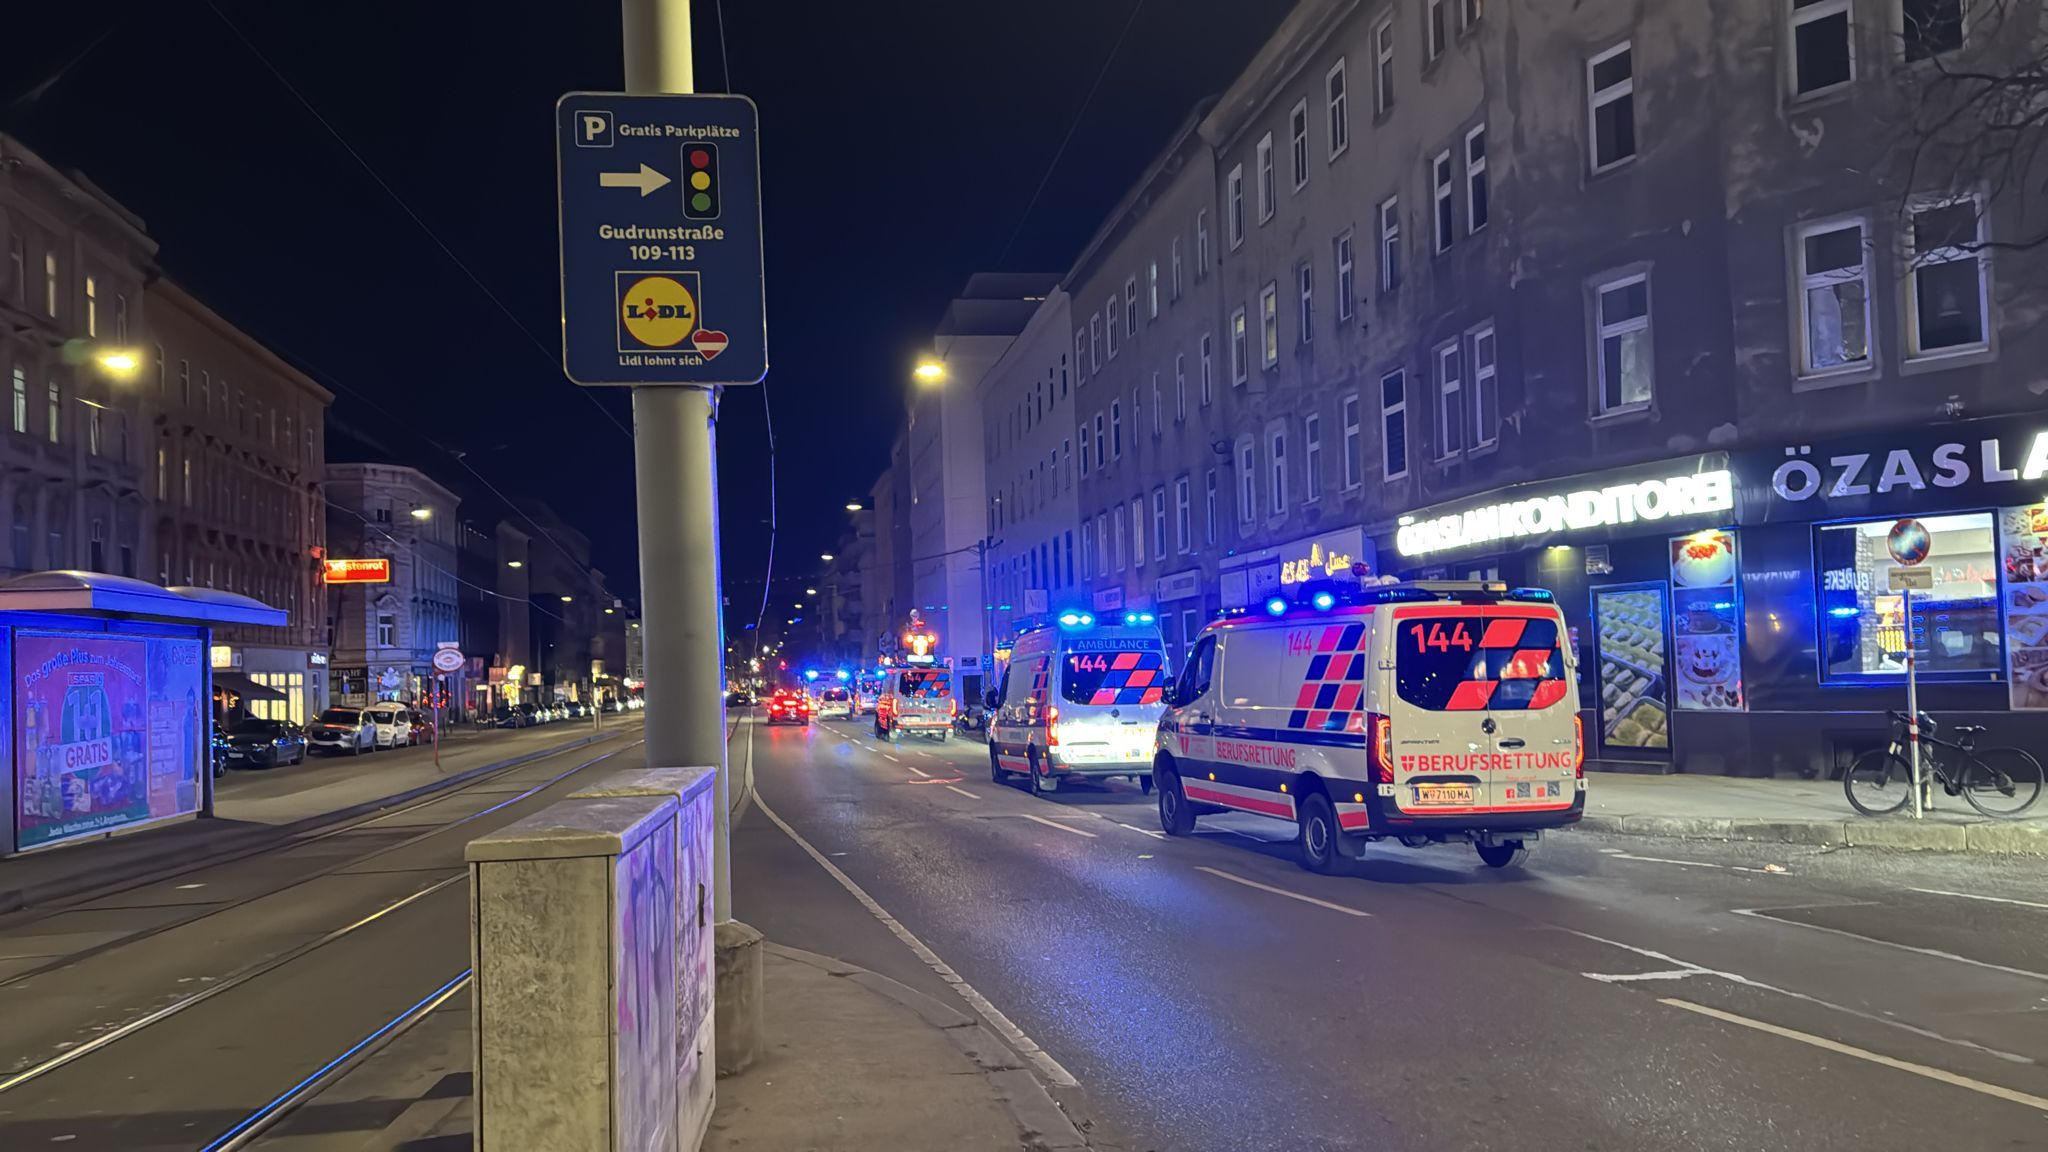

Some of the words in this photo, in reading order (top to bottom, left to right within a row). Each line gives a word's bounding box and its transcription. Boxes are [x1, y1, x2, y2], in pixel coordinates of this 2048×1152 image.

[583, 116, 606, 141] P
[619, 124, 662, 137] Gratis
[665, 125, 740, 139] Parkplätze
[599, 224, 725, 240] Gudrunstraße
[629, 245, 695, 260] 109-113
[619, 355, 642, 366] Lidl
[644, 355, 675, 366] lohnt
[678, 355, 703, 366] sich
[1499, 470, 1733, 538] KONDITOREI
[1077, 639, 1150, 650] AMBULANCE
[1288, 630, 1312, 656] 144
[1410, 622, 1473, 653] 144
[24, 669, 41, 688] Das
[41, 651, 69, 677] große
[70, 648, 89, 664] Plus
[1071, 655, 1107, 673] 144
[65, 741, 109, 768] GRATIS
[1216, 742, 1296, 768] BERUFSRETTUNG
[1418, 751, 1572, 772] BERUFSRETTUNG
[1422, 790, 1430, 800] W
